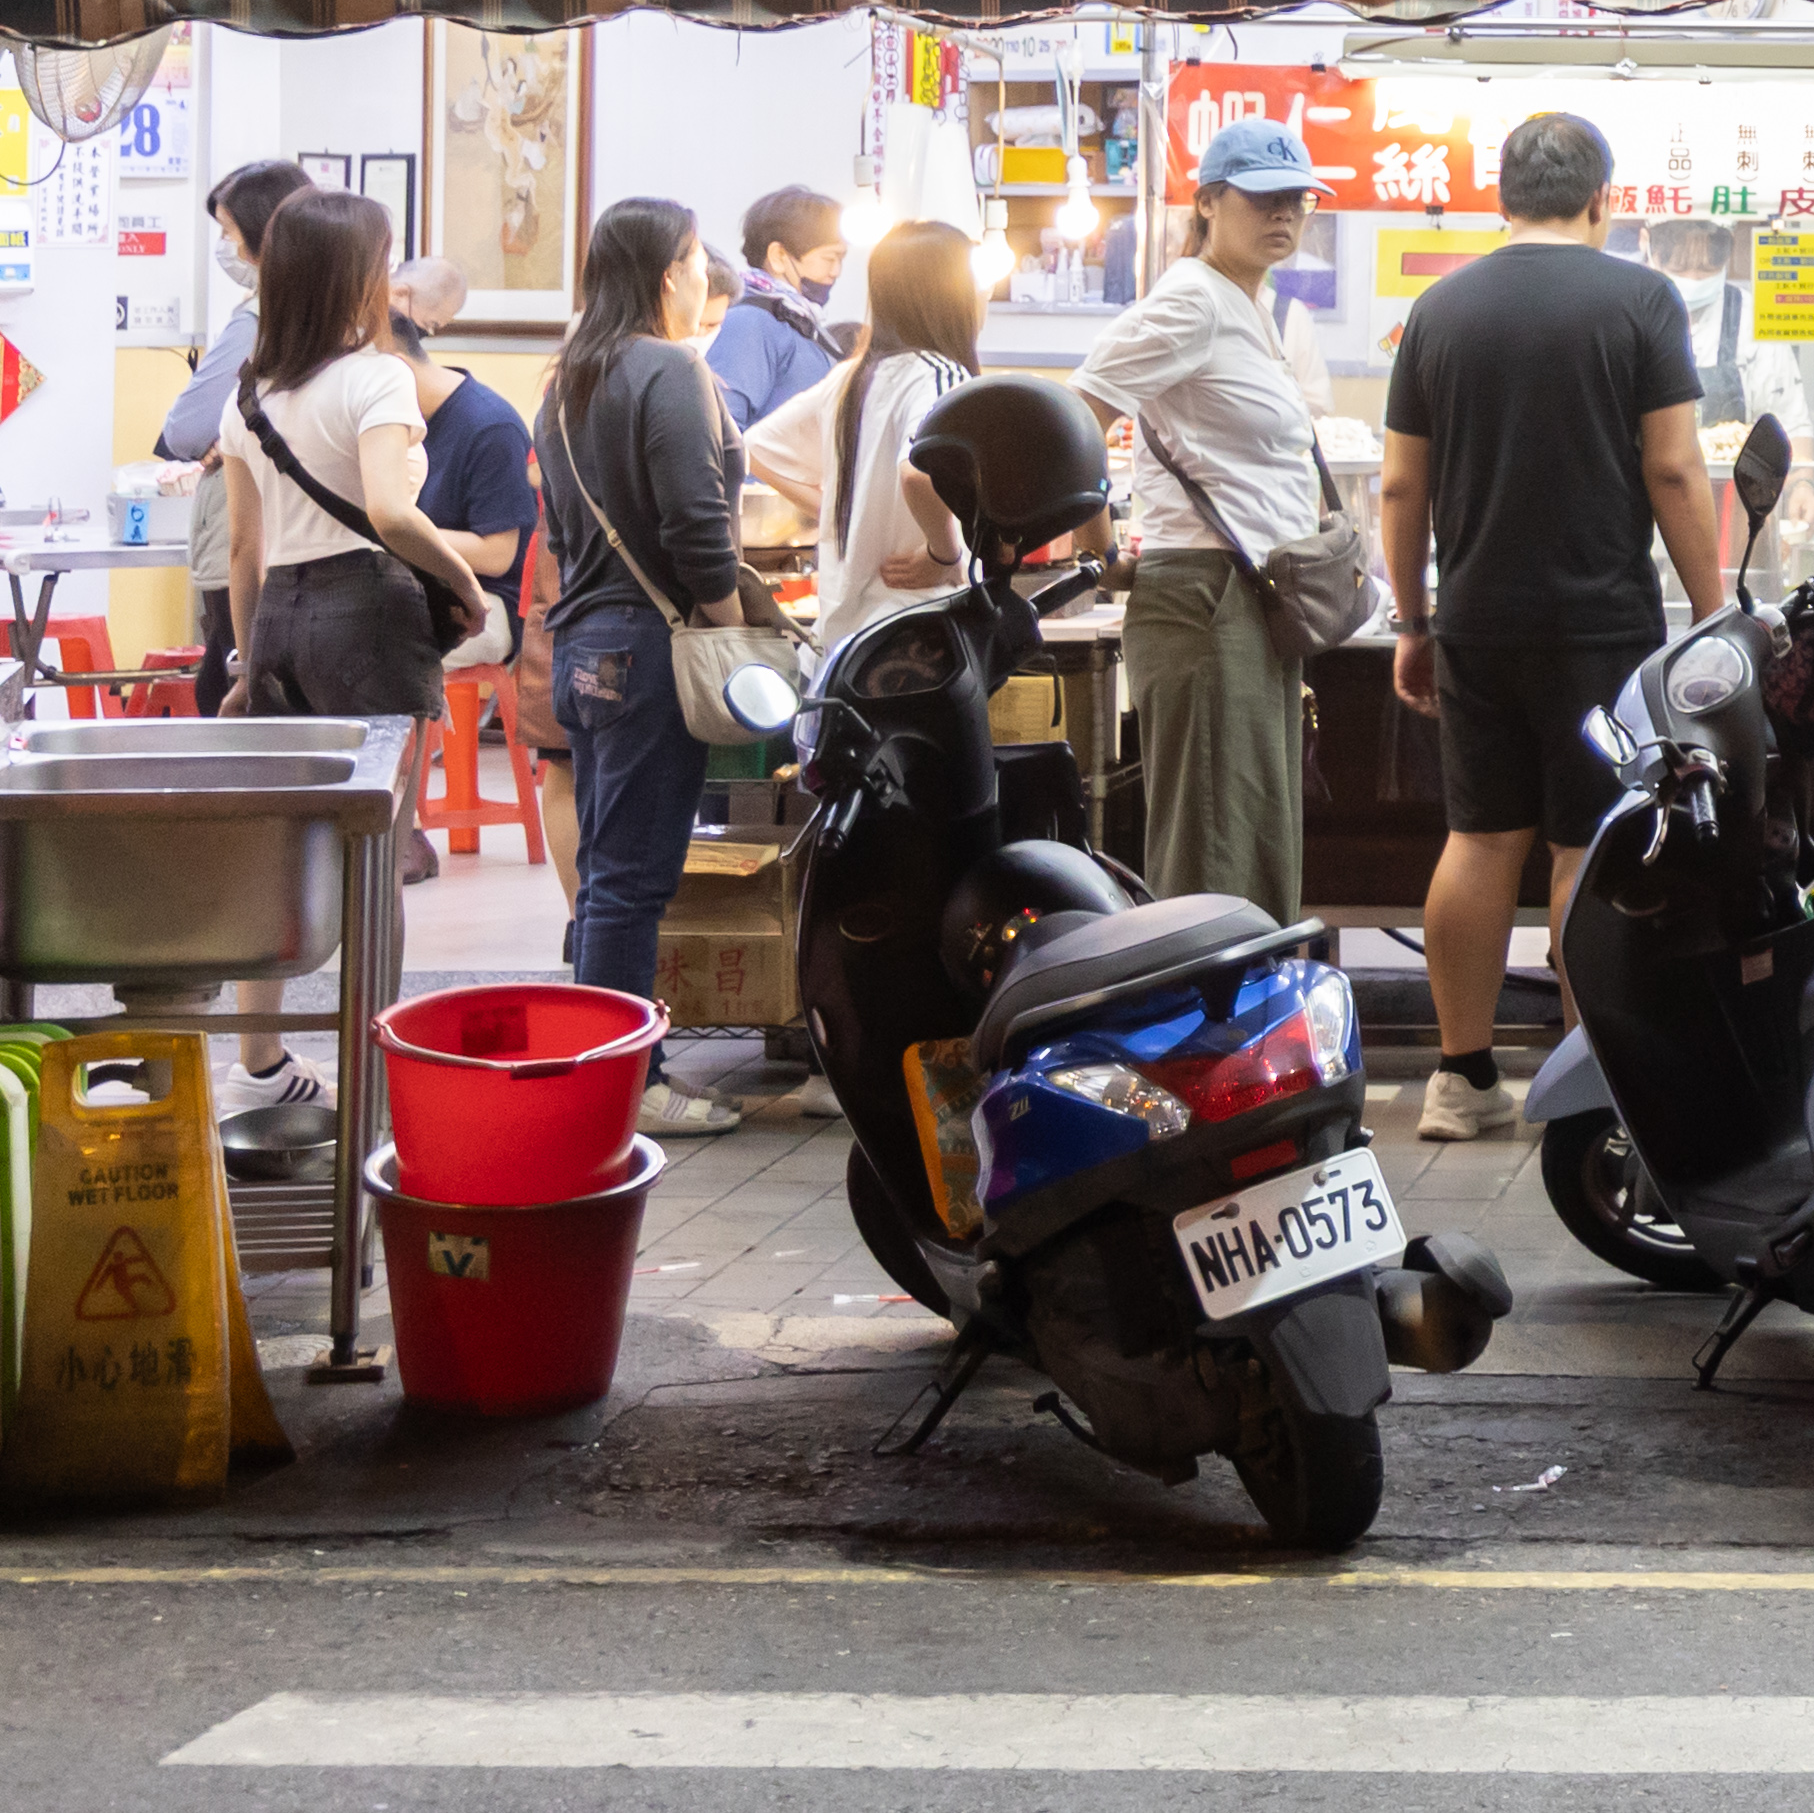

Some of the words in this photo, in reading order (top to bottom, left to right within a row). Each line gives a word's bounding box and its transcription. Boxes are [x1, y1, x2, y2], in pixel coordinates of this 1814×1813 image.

[79, 1162, 169, 1186] CAUTION
[67, 1187, 108, 1207] WET
[113, 1181, 180, 1204] FLOOR
[1190, 1179, 1388, 1294] NHA-0573
